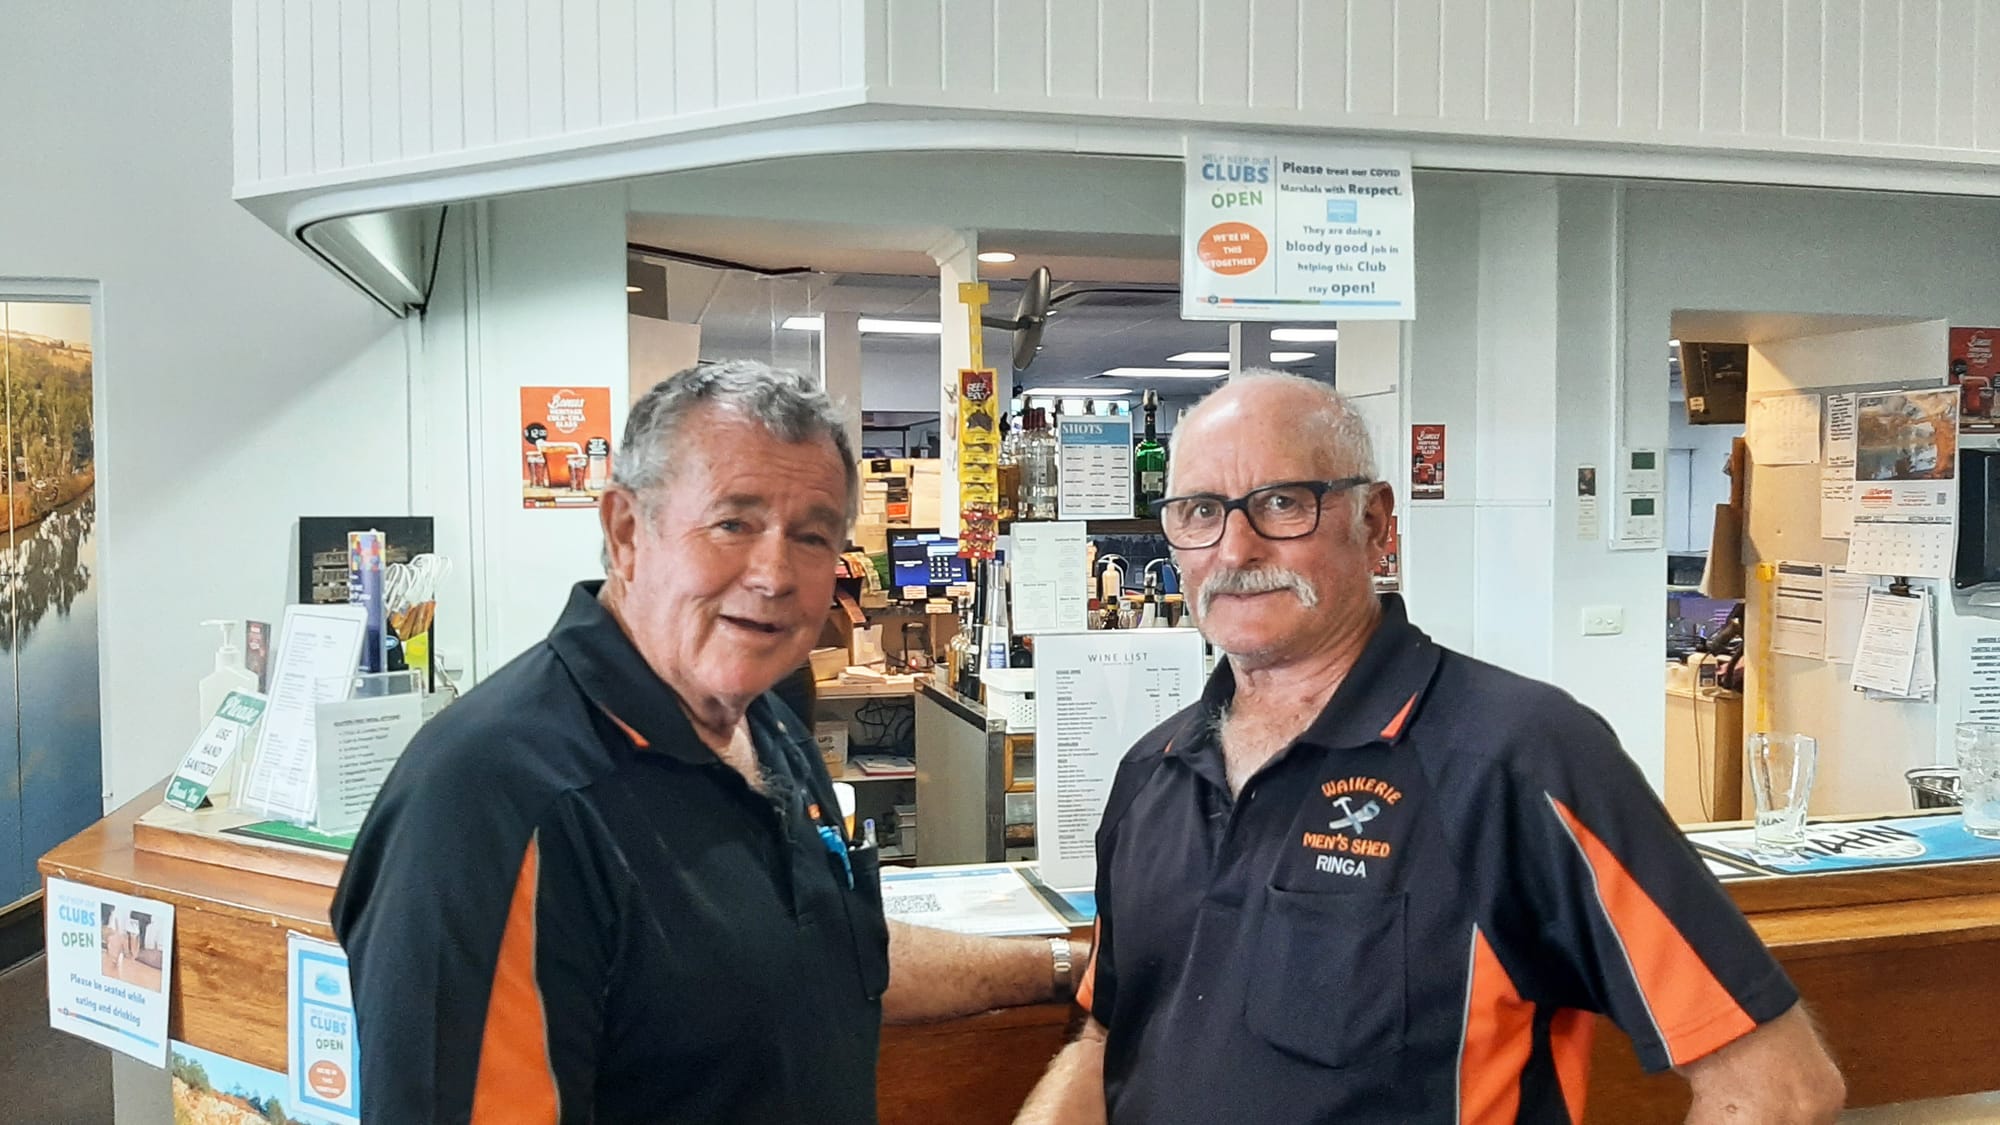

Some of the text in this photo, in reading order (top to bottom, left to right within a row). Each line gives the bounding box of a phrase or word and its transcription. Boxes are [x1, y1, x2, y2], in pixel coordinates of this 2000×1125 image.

[1202, 163, 1268, 184] CLUBS
[1282, 161, 1401, 178] Please treat our COVID
[1280, 183, 1402, 198] Marshals with Respect.
[1211, 190, 1263, 209] OPEN
[1212, 232, 1250, 243] WE'RE IN
[1303, 225, 1325, 237] They
[1345, 227, 1373, 237] doing
[1222, 245, 1242, 254] THIS
[1286, 240, 1399, 255] bloody good job in
[1210, 257, 1256, 269] TOGETHER!
[1297, 261, 1387, 273] helping this Club
[1308, 281, 1376, 296] stay open!
[1062, 423, 1103, 434] SHOTS
[1087, 652, 1148, 662] WINE LIST
[1321, 776, 1403, 806] WAIKERIE
[1302, 831, 1392, 858] MEN'S SHED
[1315, 854, 1367, 878] RINGA
[58, 904, 96, 927] CLUBS
[61, 931, 95, 948] OPEN
[70, 972, 146, 1005] Please be seated while
[75, 995, 142, 1028] eating and drinking
[310, 1015, 347, 1036] CLUBS
[315, 1038, 344, 1051] OPEN
